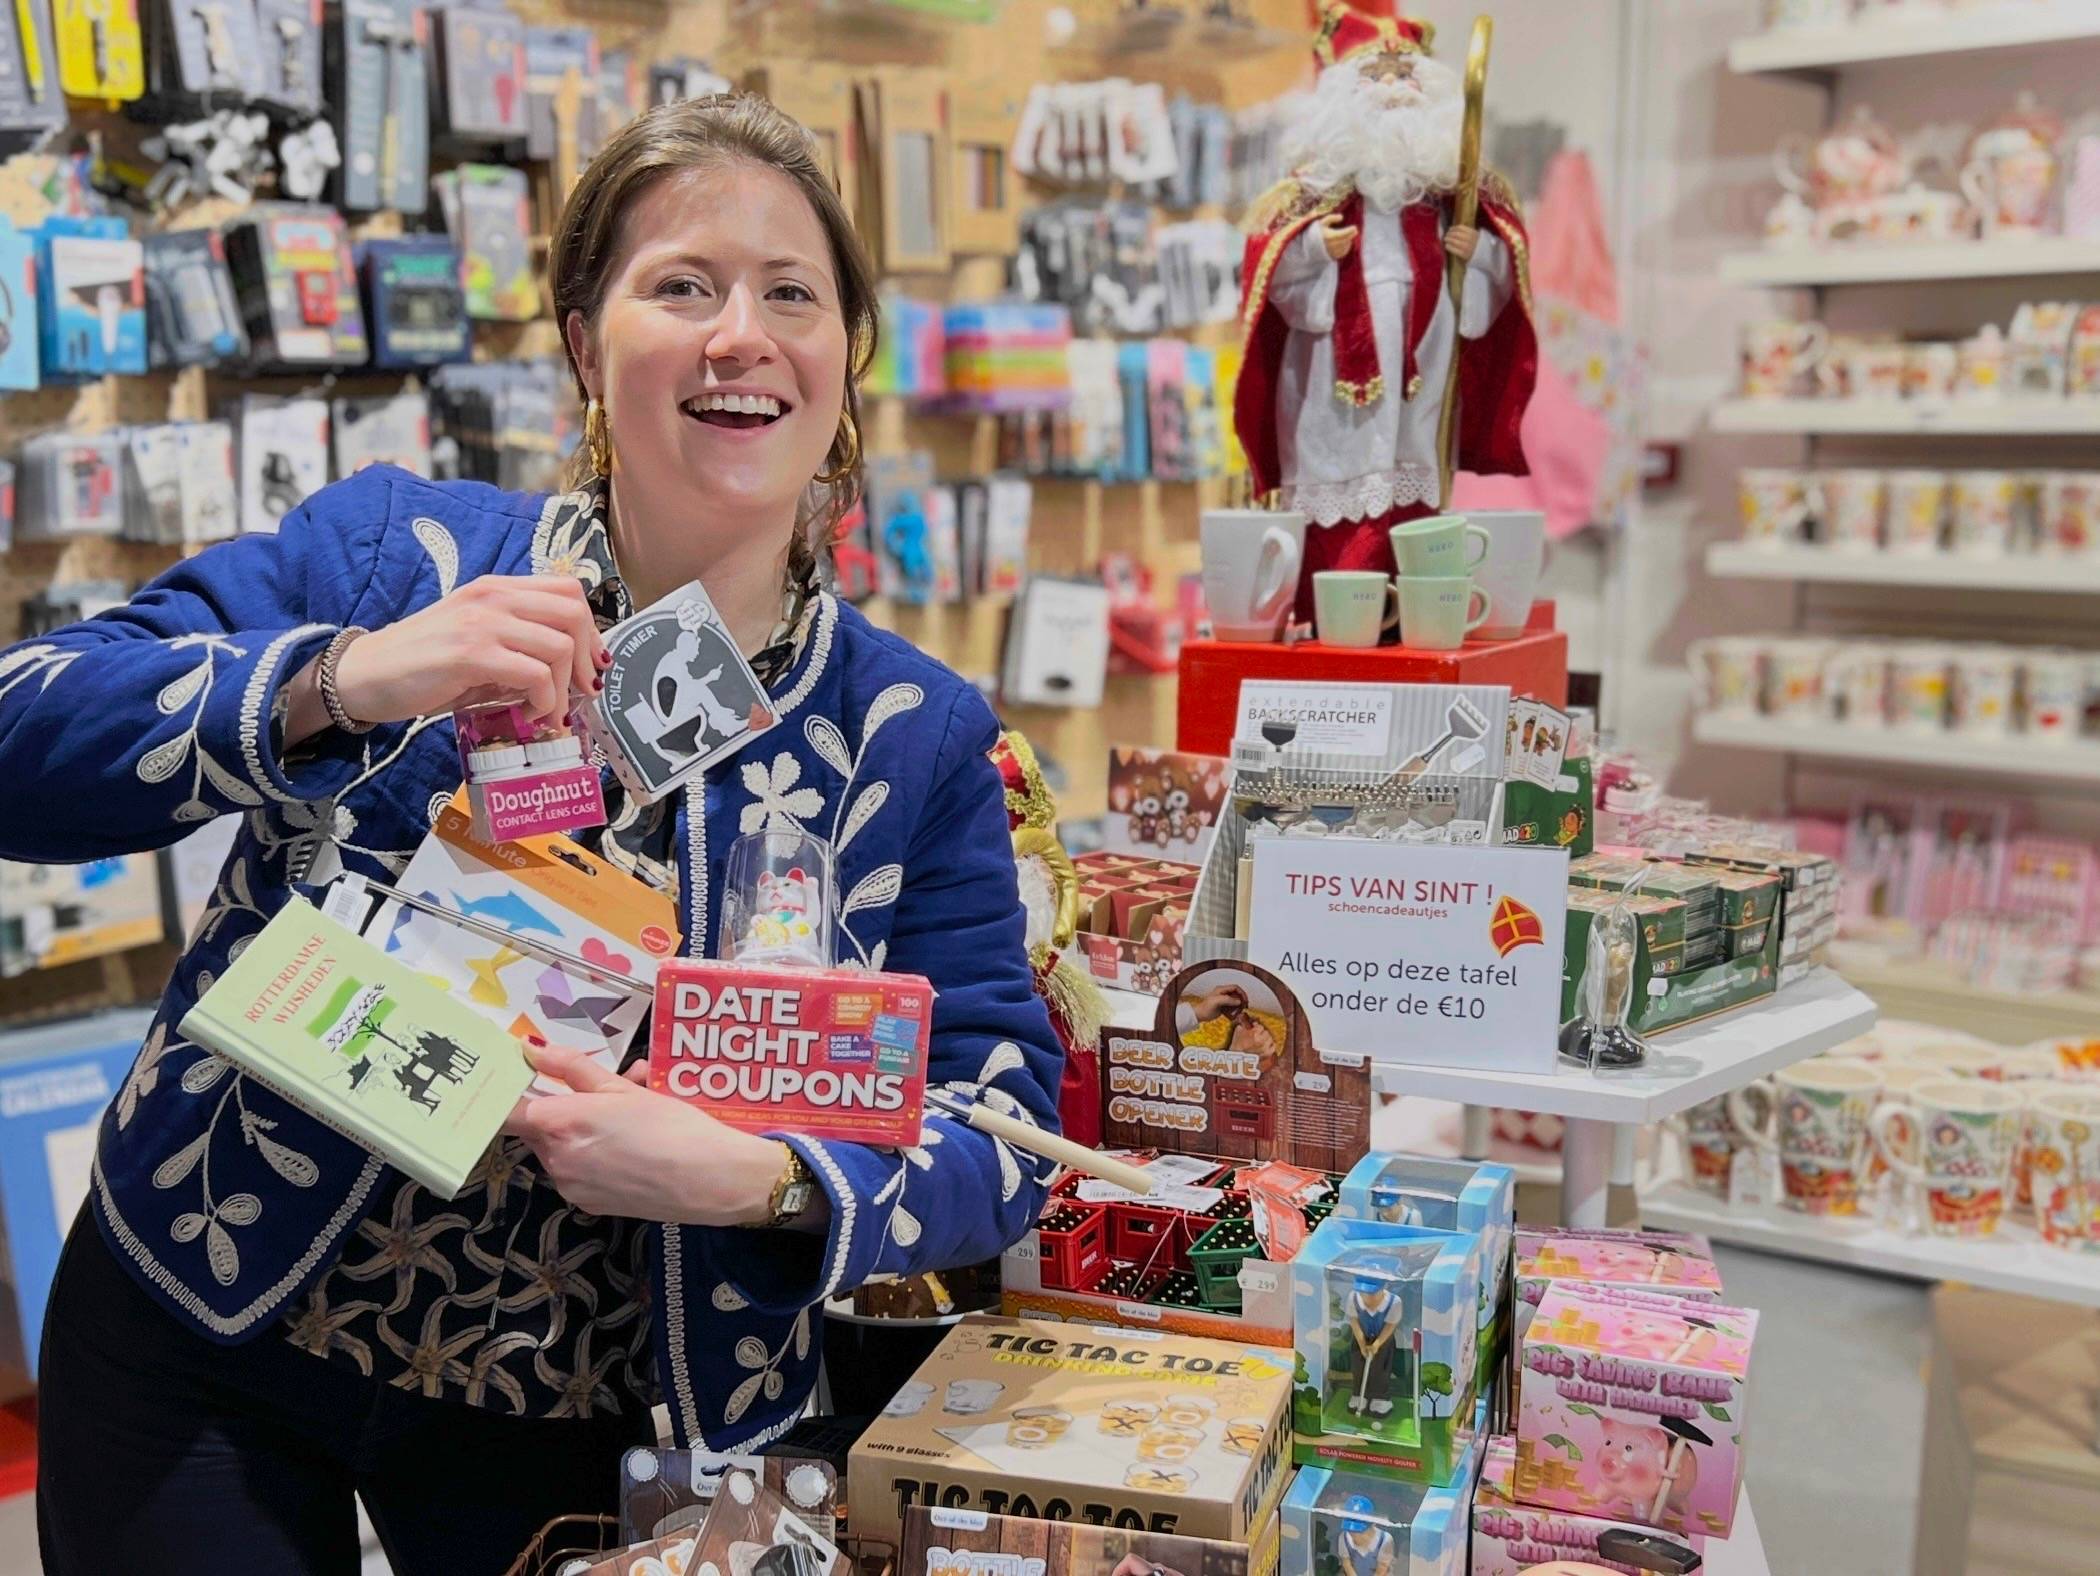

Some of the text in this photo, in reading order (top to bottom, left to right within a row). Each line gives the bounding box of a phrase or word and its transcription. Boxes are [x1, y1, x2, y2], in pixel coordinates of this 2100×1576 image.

[610, 625, 658, 714] TOILET TIMER
[1248, 696, 1385, 710] extendable
[1248, 708, 1376, 724] BACKSCRATCHER
[491, 778, 594, 813] Doughnut
[446, 817, 458, 831] 5
[496, 801, 597, 829] CONTACT LENS CASE
[1286, 874, 1493, 906] TIPS VAN SINT !
[1328, 901, 1448, 920] schoencadeautjes
[245, 932, 326, 1023] ROTTERDAMSE
[1279, 951, 1518, 986] Alles op deze tafel
[272, 954, 336, 1023] WIJSHEDEN
[900, 996, 919, 1008] 100
[673, 982, 801, 1026] DATE
[1312, 990, 1485, 1020] onder de €10
[670, 1022, 819, 1066] NIGHT
[830, 1042, 852, 1050] CAKE
[831, 1050, 872, 1058] TOGETHER
[1110, 1038, 1259, 1078] BEER CRATE
[667, 1062, 904, 1110] COUPONS
[1110, 1069, 1204, 1102] BOTTLE
[1110, 1097, 1206, 1130] OPENER
[1018, 1248, 1034, 1258] 299
[1082, 1250, 1098, 1270] BEER
[1256, 1280, 1276, 1290] 299
[987, 1333, 1246, 1376] TIC TAC TOE
[992, 1352, 1132, 1377] DRINKING
[1556, 1380, 1608, 1406] WITH
[1576, 1354, 1657, 1392] SAVING
[1660, 1372, 1734, 1403] BANK
[867, 1442, 894, 1452] with
[906, 1448, 951, 1458] glasses
[1338, 1451, 1366, 1460] POWERED
[1367, 1456, 1393, 1464] NOVELTY
[1242, 1402, 1290, 1536] TIC TAC TO
